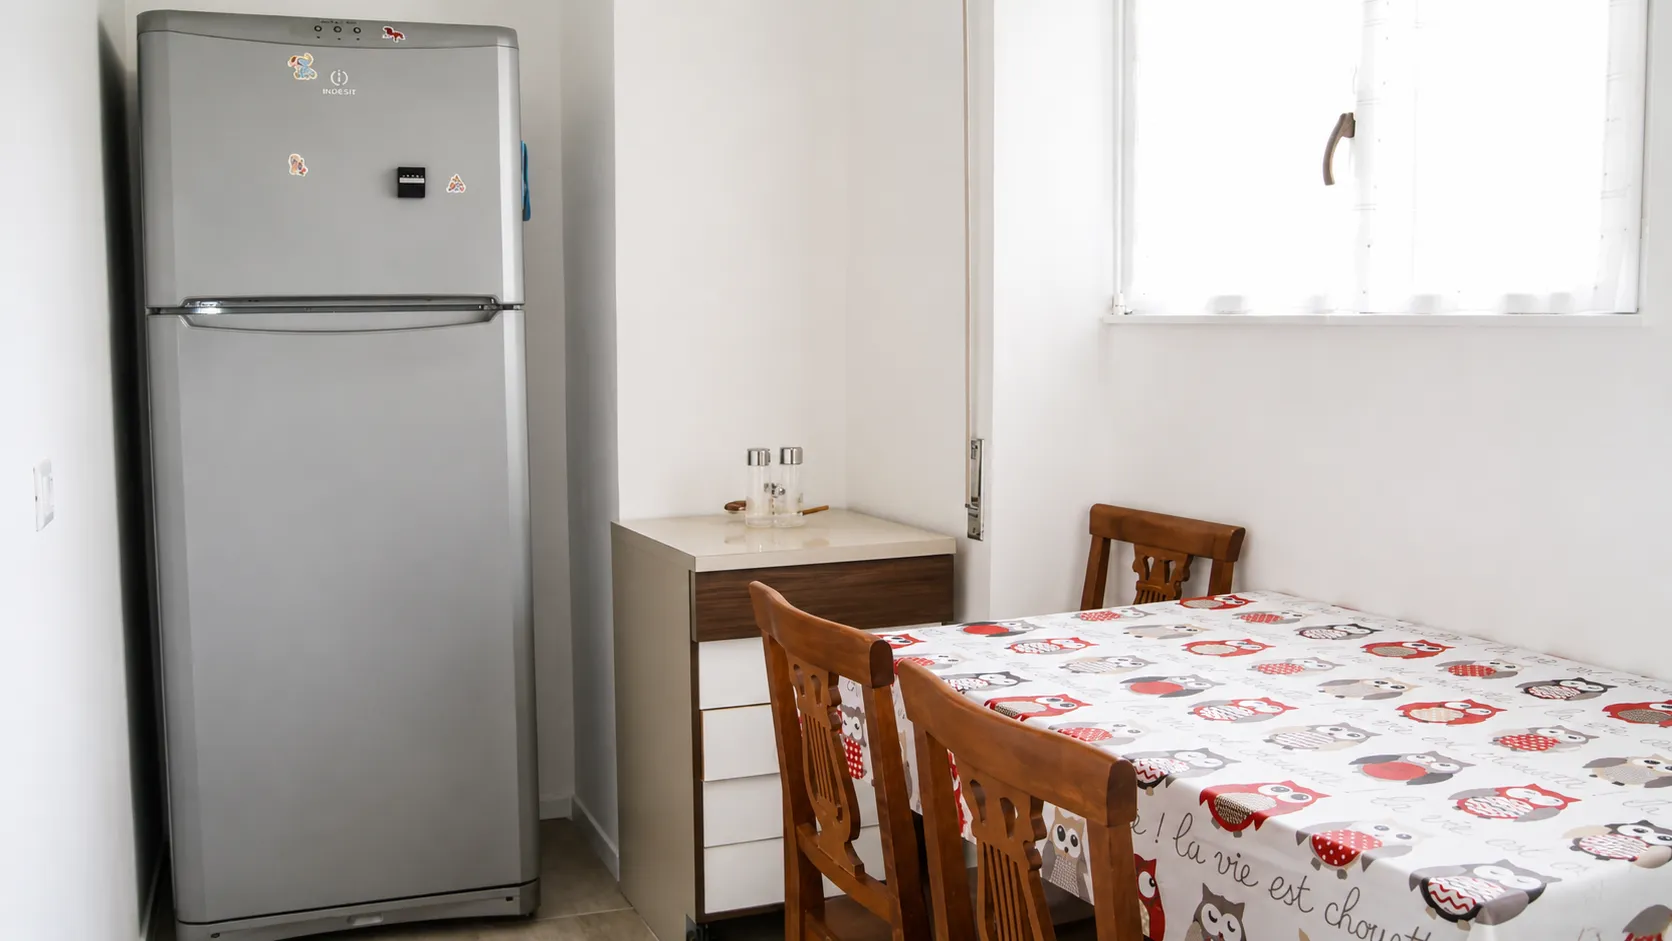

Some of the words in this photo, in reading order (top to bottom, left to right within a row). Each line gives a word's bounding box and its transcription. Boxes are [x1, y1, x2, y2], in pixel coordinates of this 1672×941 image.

[1172, 812, 1206, 865] la
[1213, 851, 1260, 888] vie
[1267, 875, 1314, 914] est
